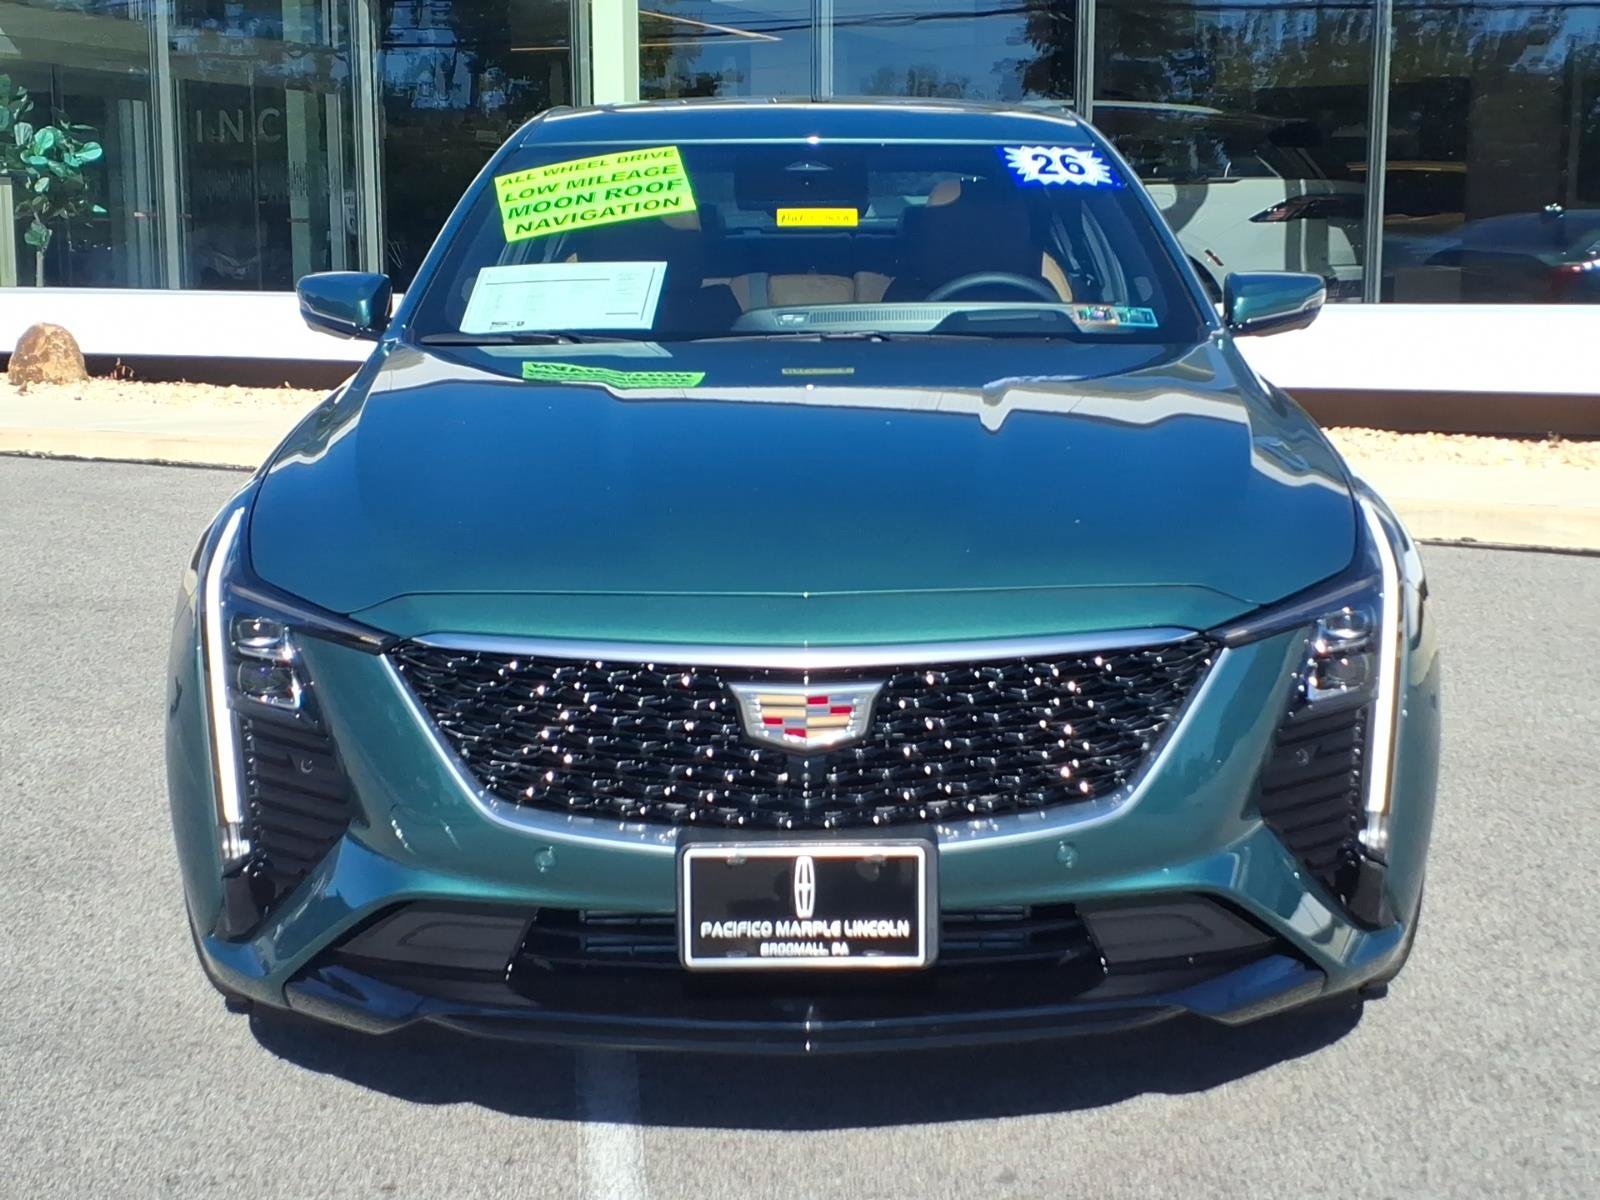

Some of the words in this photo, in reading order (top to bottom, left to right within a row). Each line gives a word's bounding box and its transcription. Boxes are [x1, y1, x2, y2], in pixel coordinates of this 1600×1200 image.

[501, 173, 537, 187] ALL
[543, 159, 610, 178] WHEEL
[617, 149, 675, 165] DRIVE
[504, 182, 561, 203] LOW
[566, 164, 680, 190] MILEAGE
[1031, 153, 1087, 176] 26
[507, 192, 596, 219] MOON
[605, 178, 684, 200] ROOF
[515, 196, 681, 234] NAVIGATION
[700, 920, 773, 939] PACIFICO
[775, 919, 842, 939] MARPLE
[843, 919, 911, 939] LINCOLN
[831, 941, 850, 957] PA
